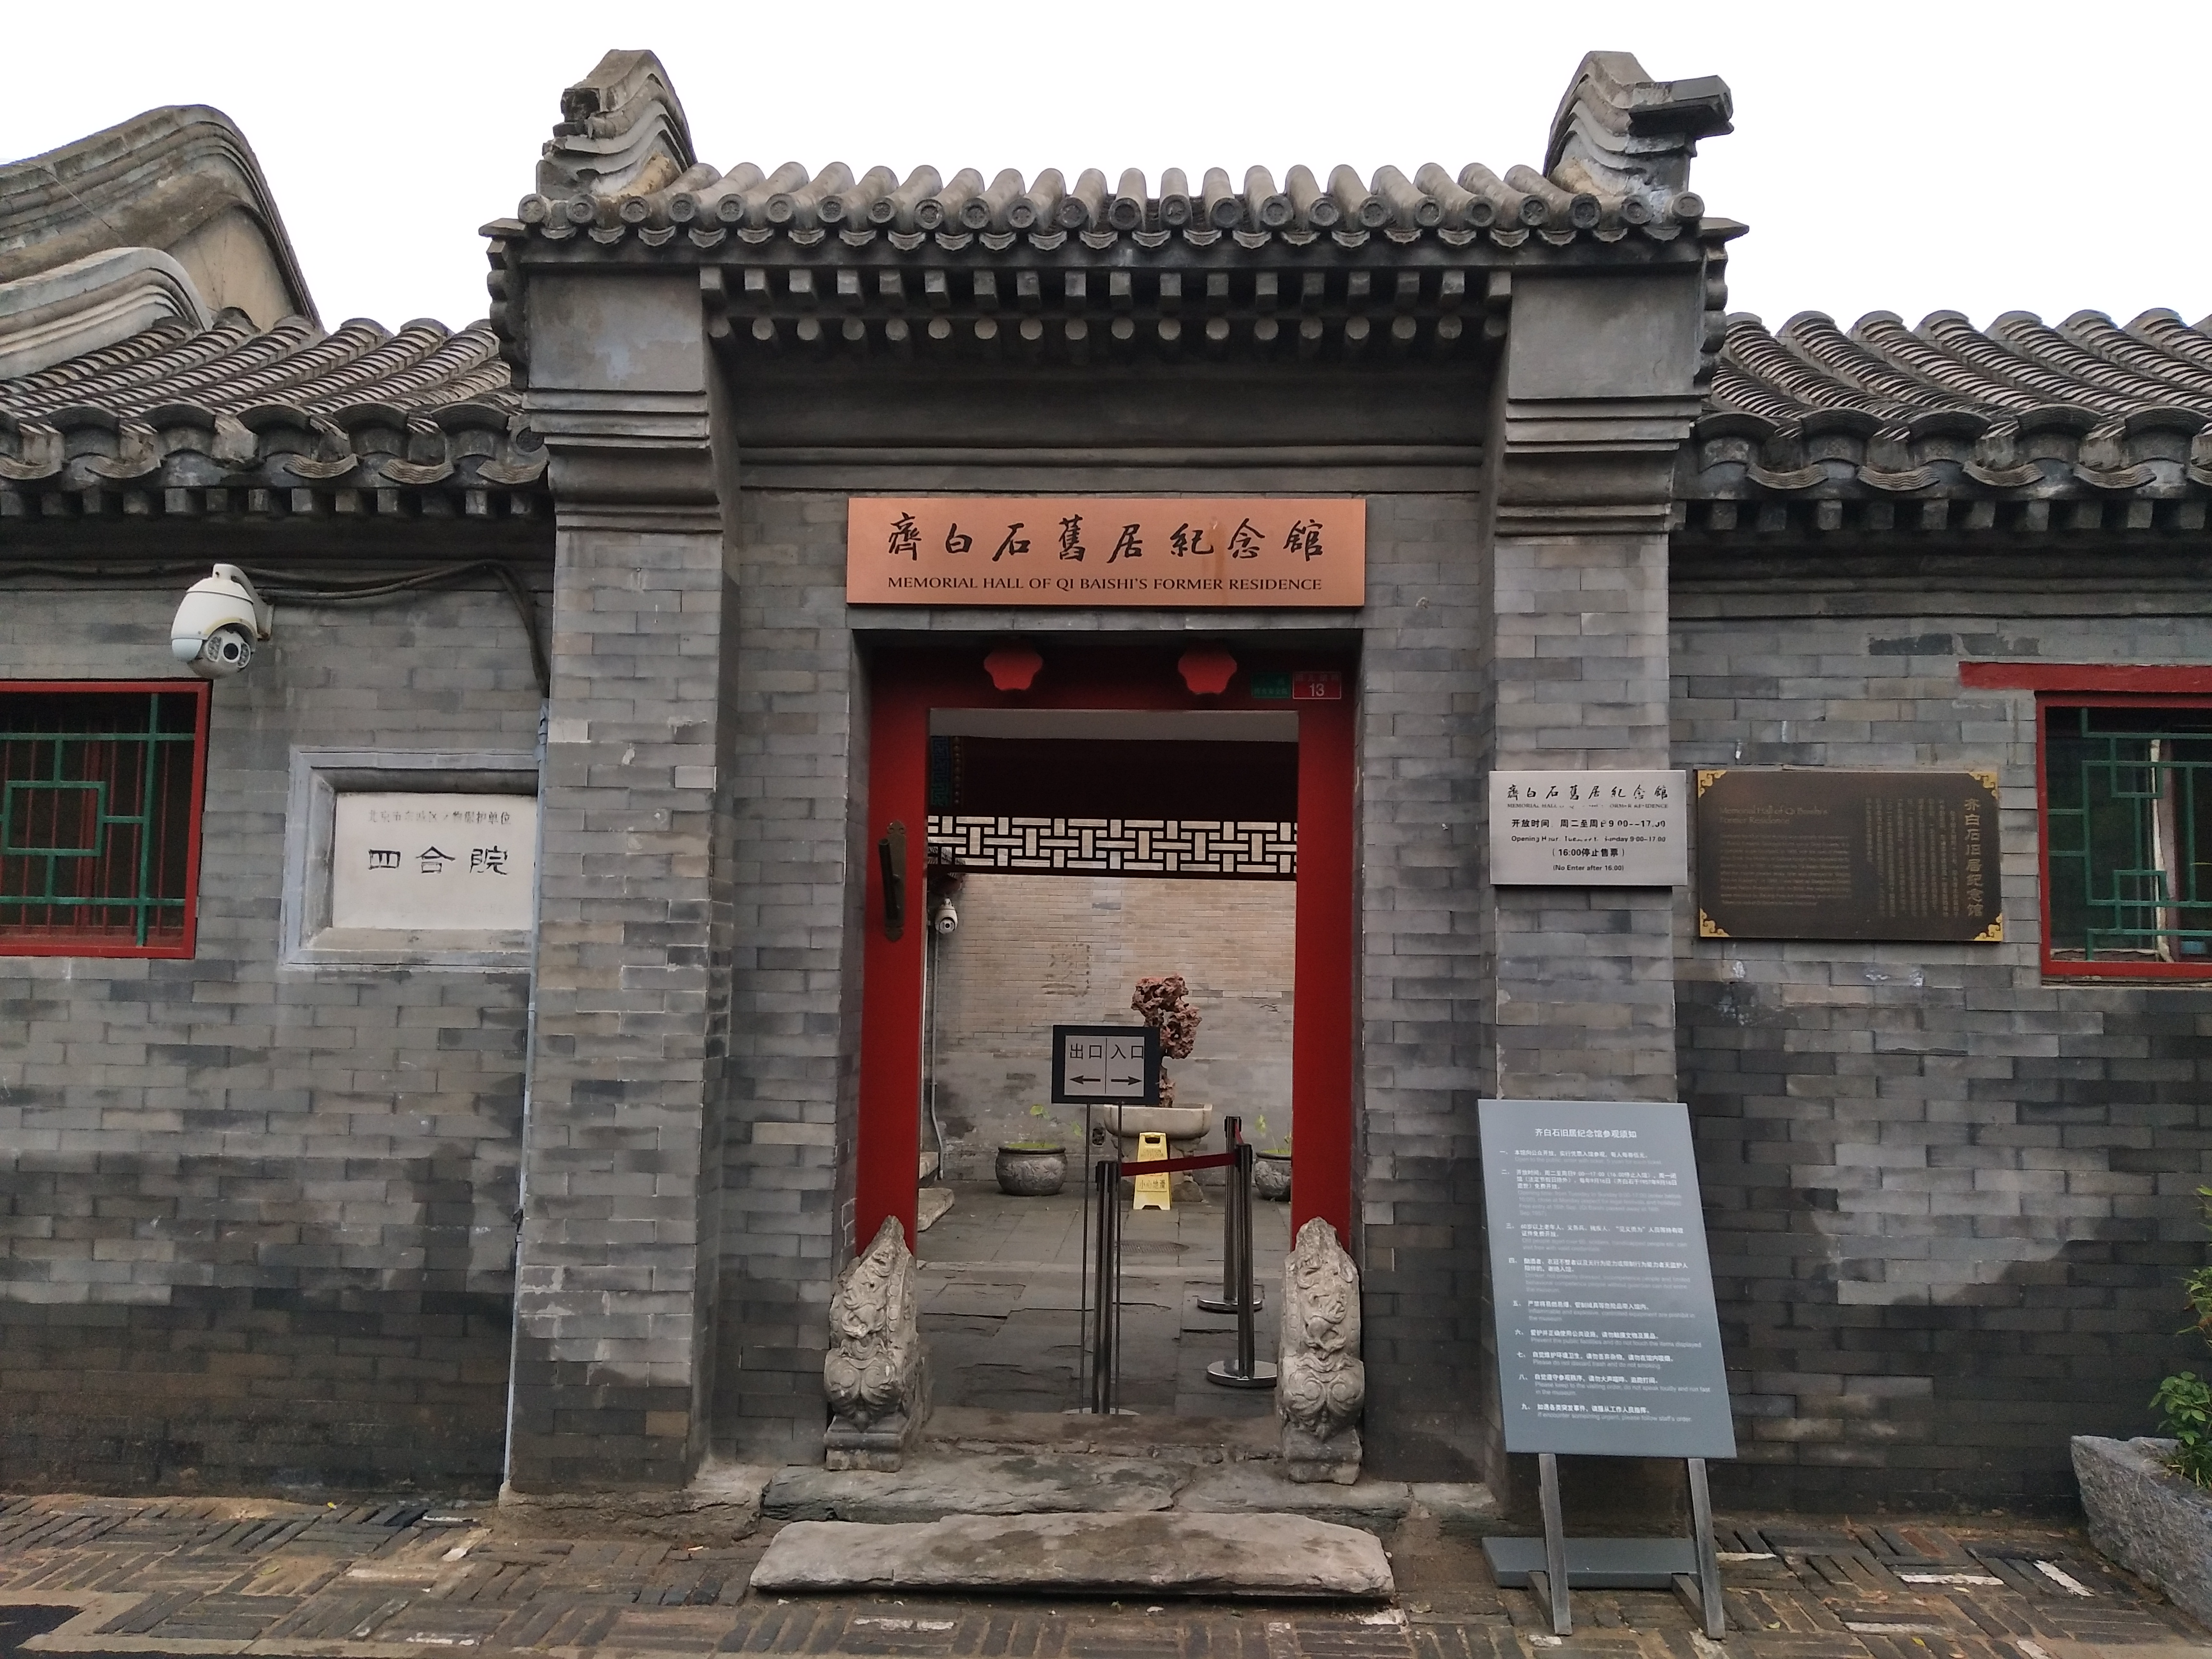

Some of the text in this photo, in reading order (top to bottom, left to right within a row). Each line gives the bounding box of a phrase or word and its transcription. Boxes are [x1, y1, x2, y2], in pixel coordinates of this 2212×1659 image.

[888, 512, 1324, 565] 齊白石舊居紀念館
[888, 576, 1322, 591] MEMORIAL HALL OF QI BAISHI'S FORMER RESIDENCE
[1310, 683, 1324, 697] 13
[368, 809, 511, 825] 北京市东城区物保护单位
[368, 845, 509, 875] 四合院
[1070, 1043, 1103, 1060] 出口
[1110, 1044, 1144, 1060] 入口
[1534, 1128, 1637, 1139] 齐白石旧居纪念馆参观须知
[1140, 1179, 1166, 1189] 小心地滑
